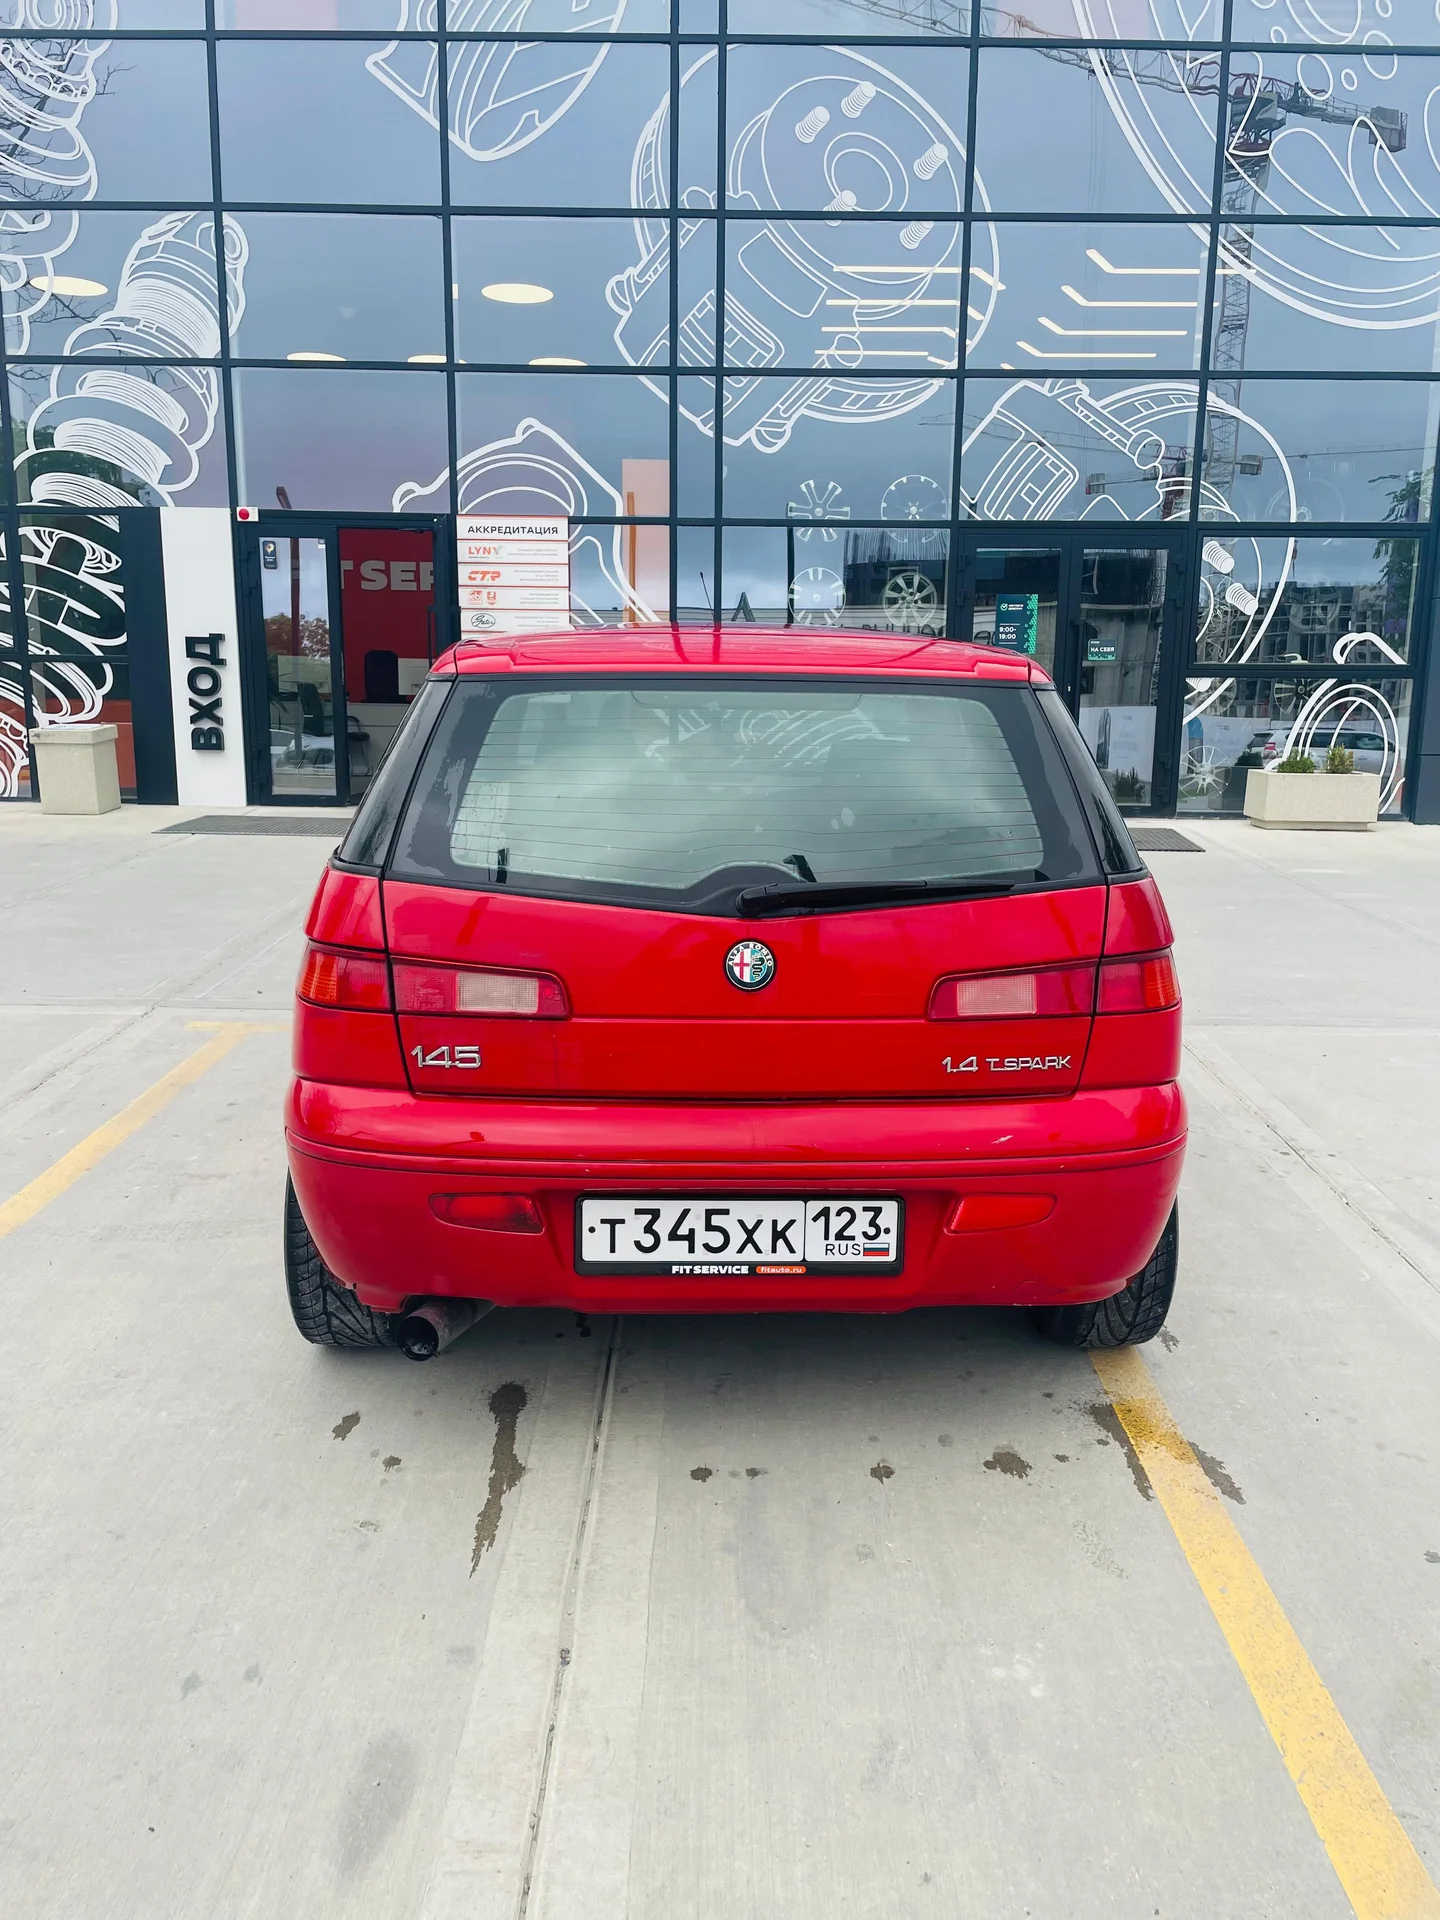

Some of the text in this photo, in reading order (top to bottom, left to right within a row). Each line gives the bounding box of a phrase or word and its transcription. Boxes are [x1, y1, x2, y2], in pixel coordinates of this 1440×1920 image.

[467, 526, 558, 535] АККРЕДИТАЦИЯ
[185, 633, 227, 751] ВХОД
[411, 1045, 482, 1069] 145
[811, 1206, 882, 1241] 123
[825, 1243, 861, 1256] RUS
[693, 1265, 749, 1275] SERVICE
[760, 1266, 803, 1274] fitauto.ru
